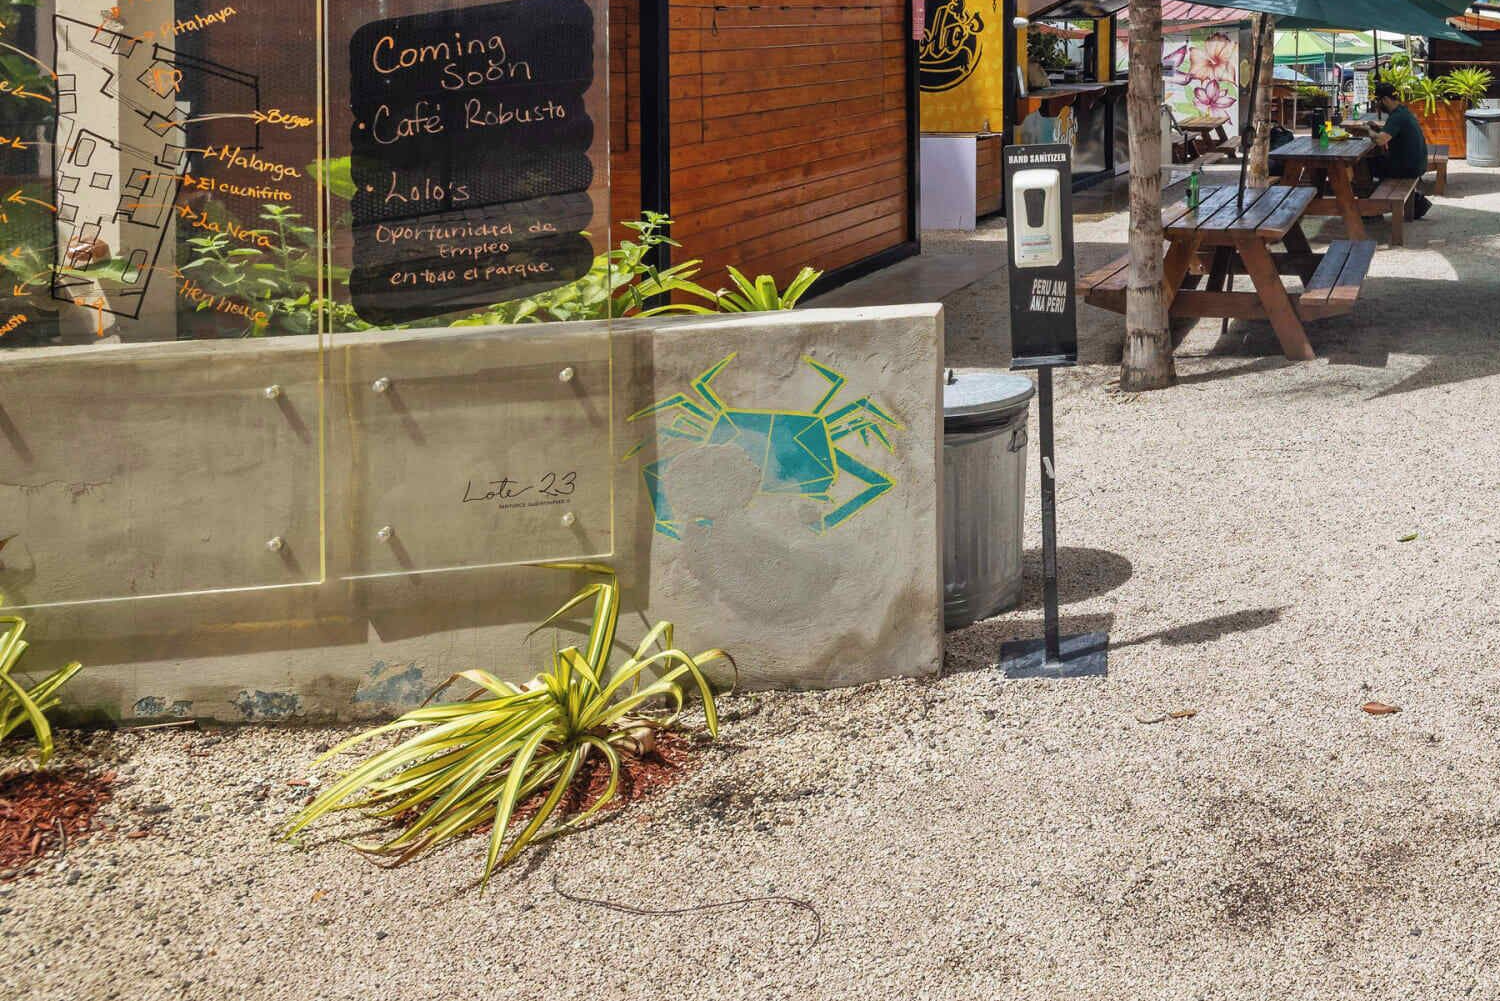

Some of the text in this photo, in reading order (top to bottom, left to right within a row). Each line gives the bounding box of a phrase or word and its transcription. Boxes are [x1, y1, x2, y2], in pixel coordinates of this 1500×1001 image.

[373, 32, 506, 74] Coming
[441, 61, 532, 90] Soon
[373, 98, 566, 144] Café Robusto
[219, 144, 302, 181] Malanga
[1008, 152, 1067, 164] HAND SANITIZER
[197, 177, 215, 190] El
[385, 171, 470, 204] Lolo's
[192, 212, 220, 232] La
[528, 220, 558, 234] de
[390, 272, 417, 285] en
[463, 269, 478, 281] el
[1032, 279, 1067, 297] PERU ANA
[1030, 296, 1066, 313] ANA PERU
[462, 471, 577, 503] Lote 23
